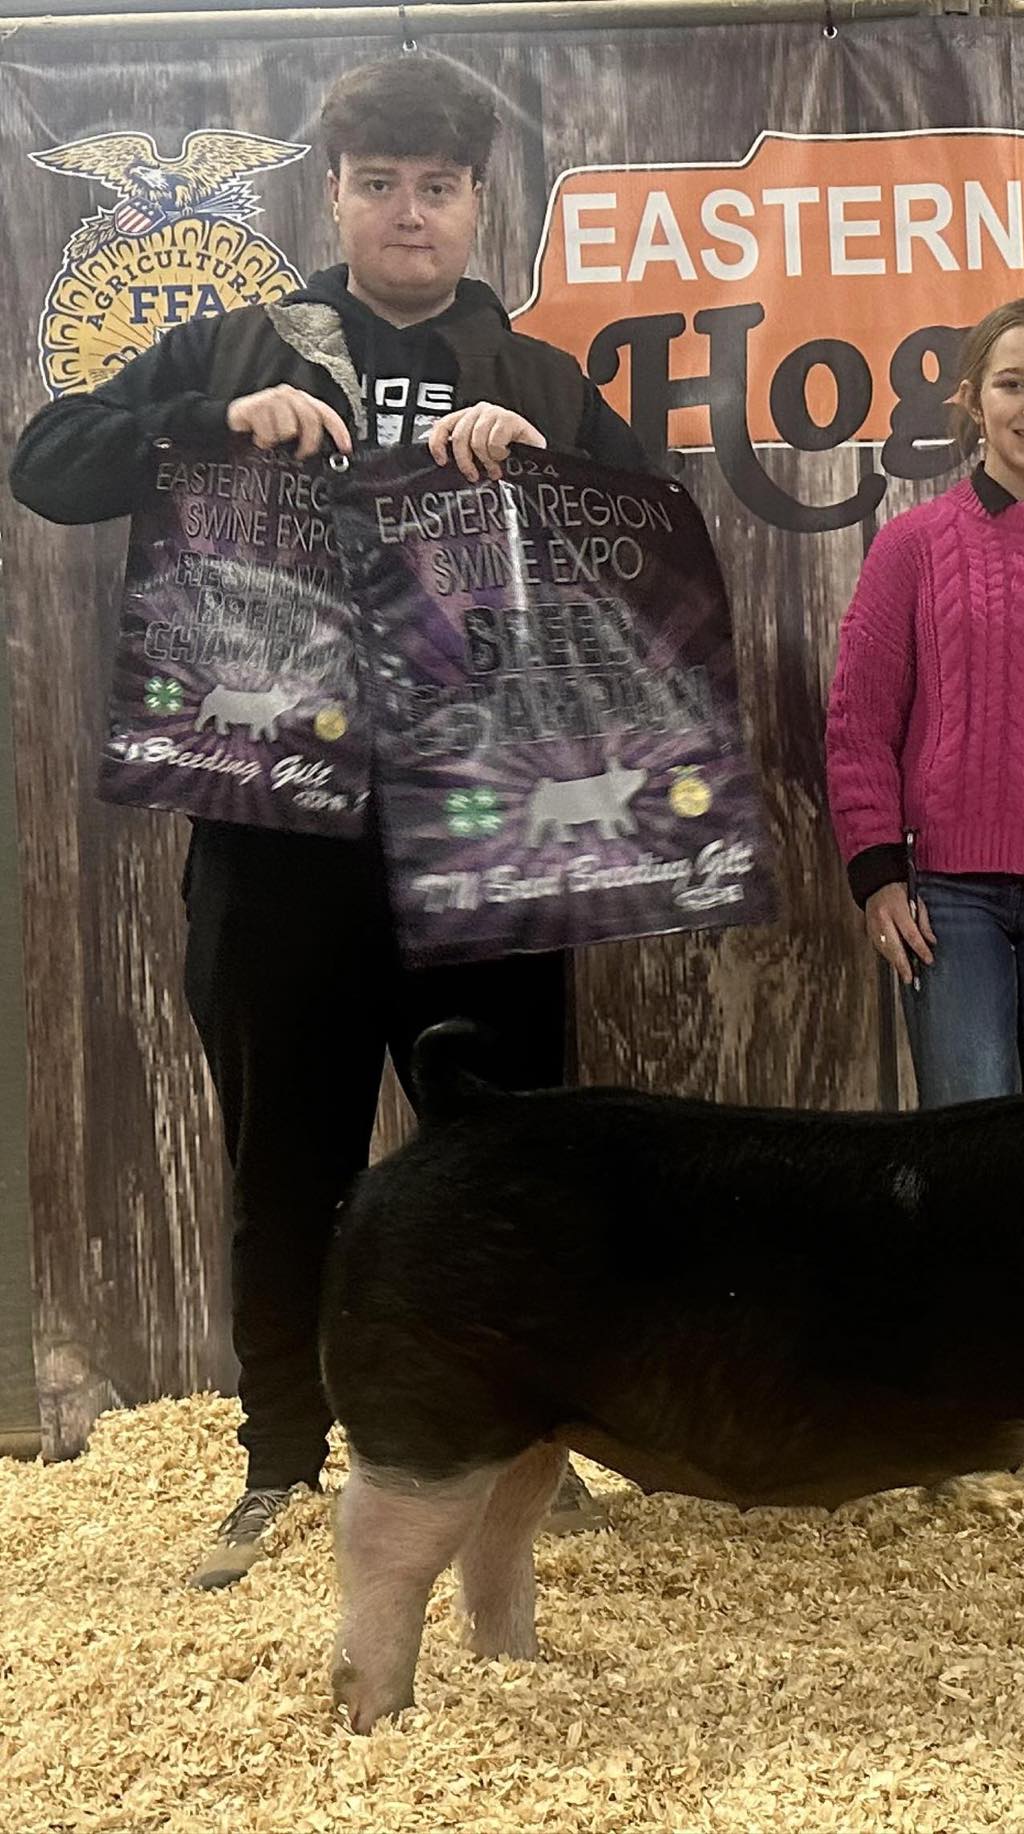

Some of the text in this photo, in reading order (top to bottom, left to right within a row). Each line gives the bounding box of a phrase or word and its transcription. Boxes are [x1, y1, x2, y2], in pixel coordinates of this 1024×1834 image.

[562, 180, 1024, 284] EASTERN
[86, 249, 263, 332] AGRICULTURA
[127, 283, 229, 325] FFA
[587, 302, 985, 534] Hog
[155, 461, 332, 513] EASTERN REG
[505, 456, 560, 479] 024
[185, 502, 269, 546] SWINE
[374, 481, 674, 545] EASTERN REGION
[431, 535, 646, 596] SWINE EXPO
